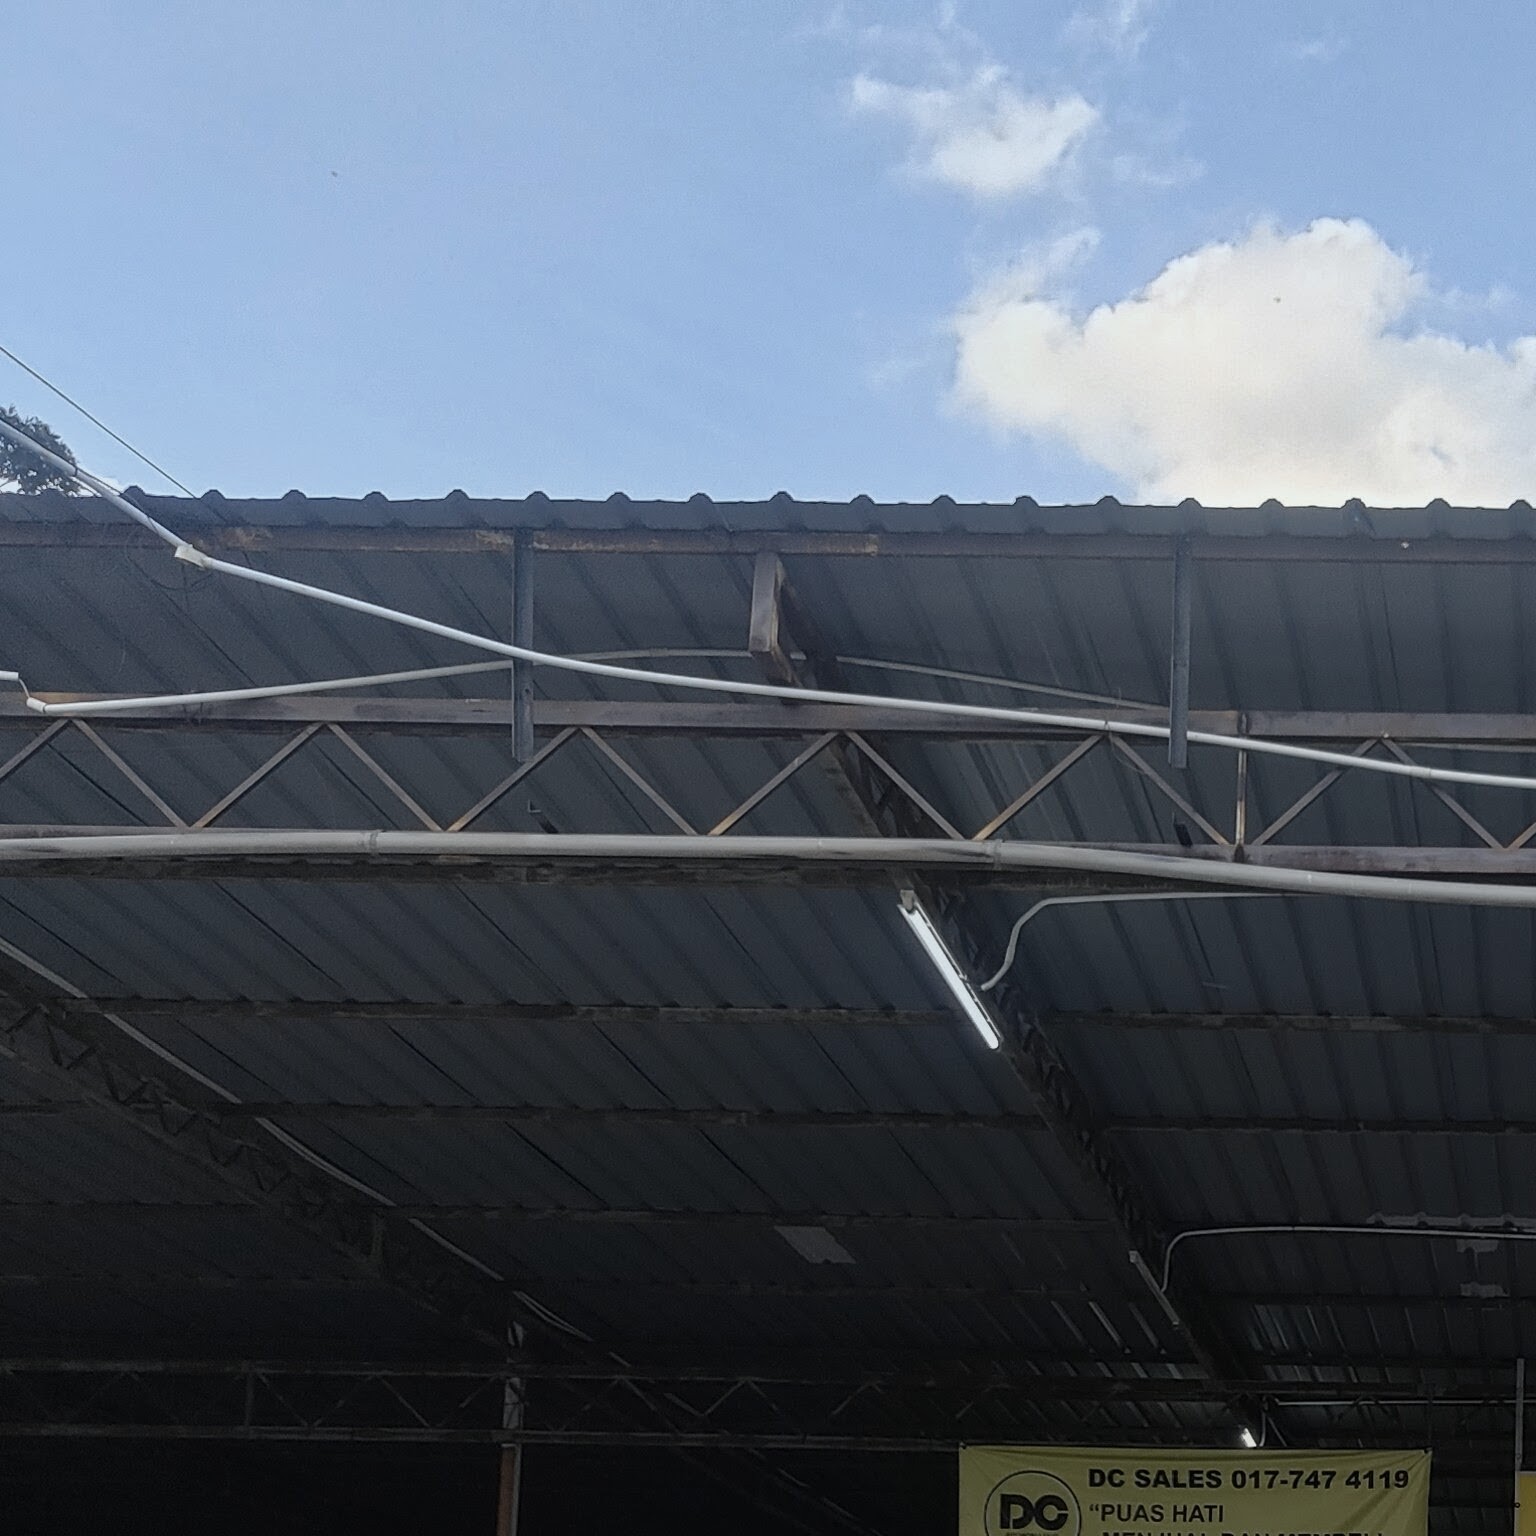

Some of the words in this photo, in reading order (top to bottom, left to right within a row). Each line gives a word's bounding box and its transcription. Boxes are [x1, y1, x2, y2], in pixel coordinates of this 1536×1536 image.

[1088, 1469, 1125, 1487] DC
[1134, 1470, 1222, 1488] SALES
[1231, 1470, 1337, 1489] 017-747
[1345, 1470, 1409, 1489] 4119
[1000, 1493, 1069, 1531] DC
[1172, 1505, 1224, 1523] HATI
